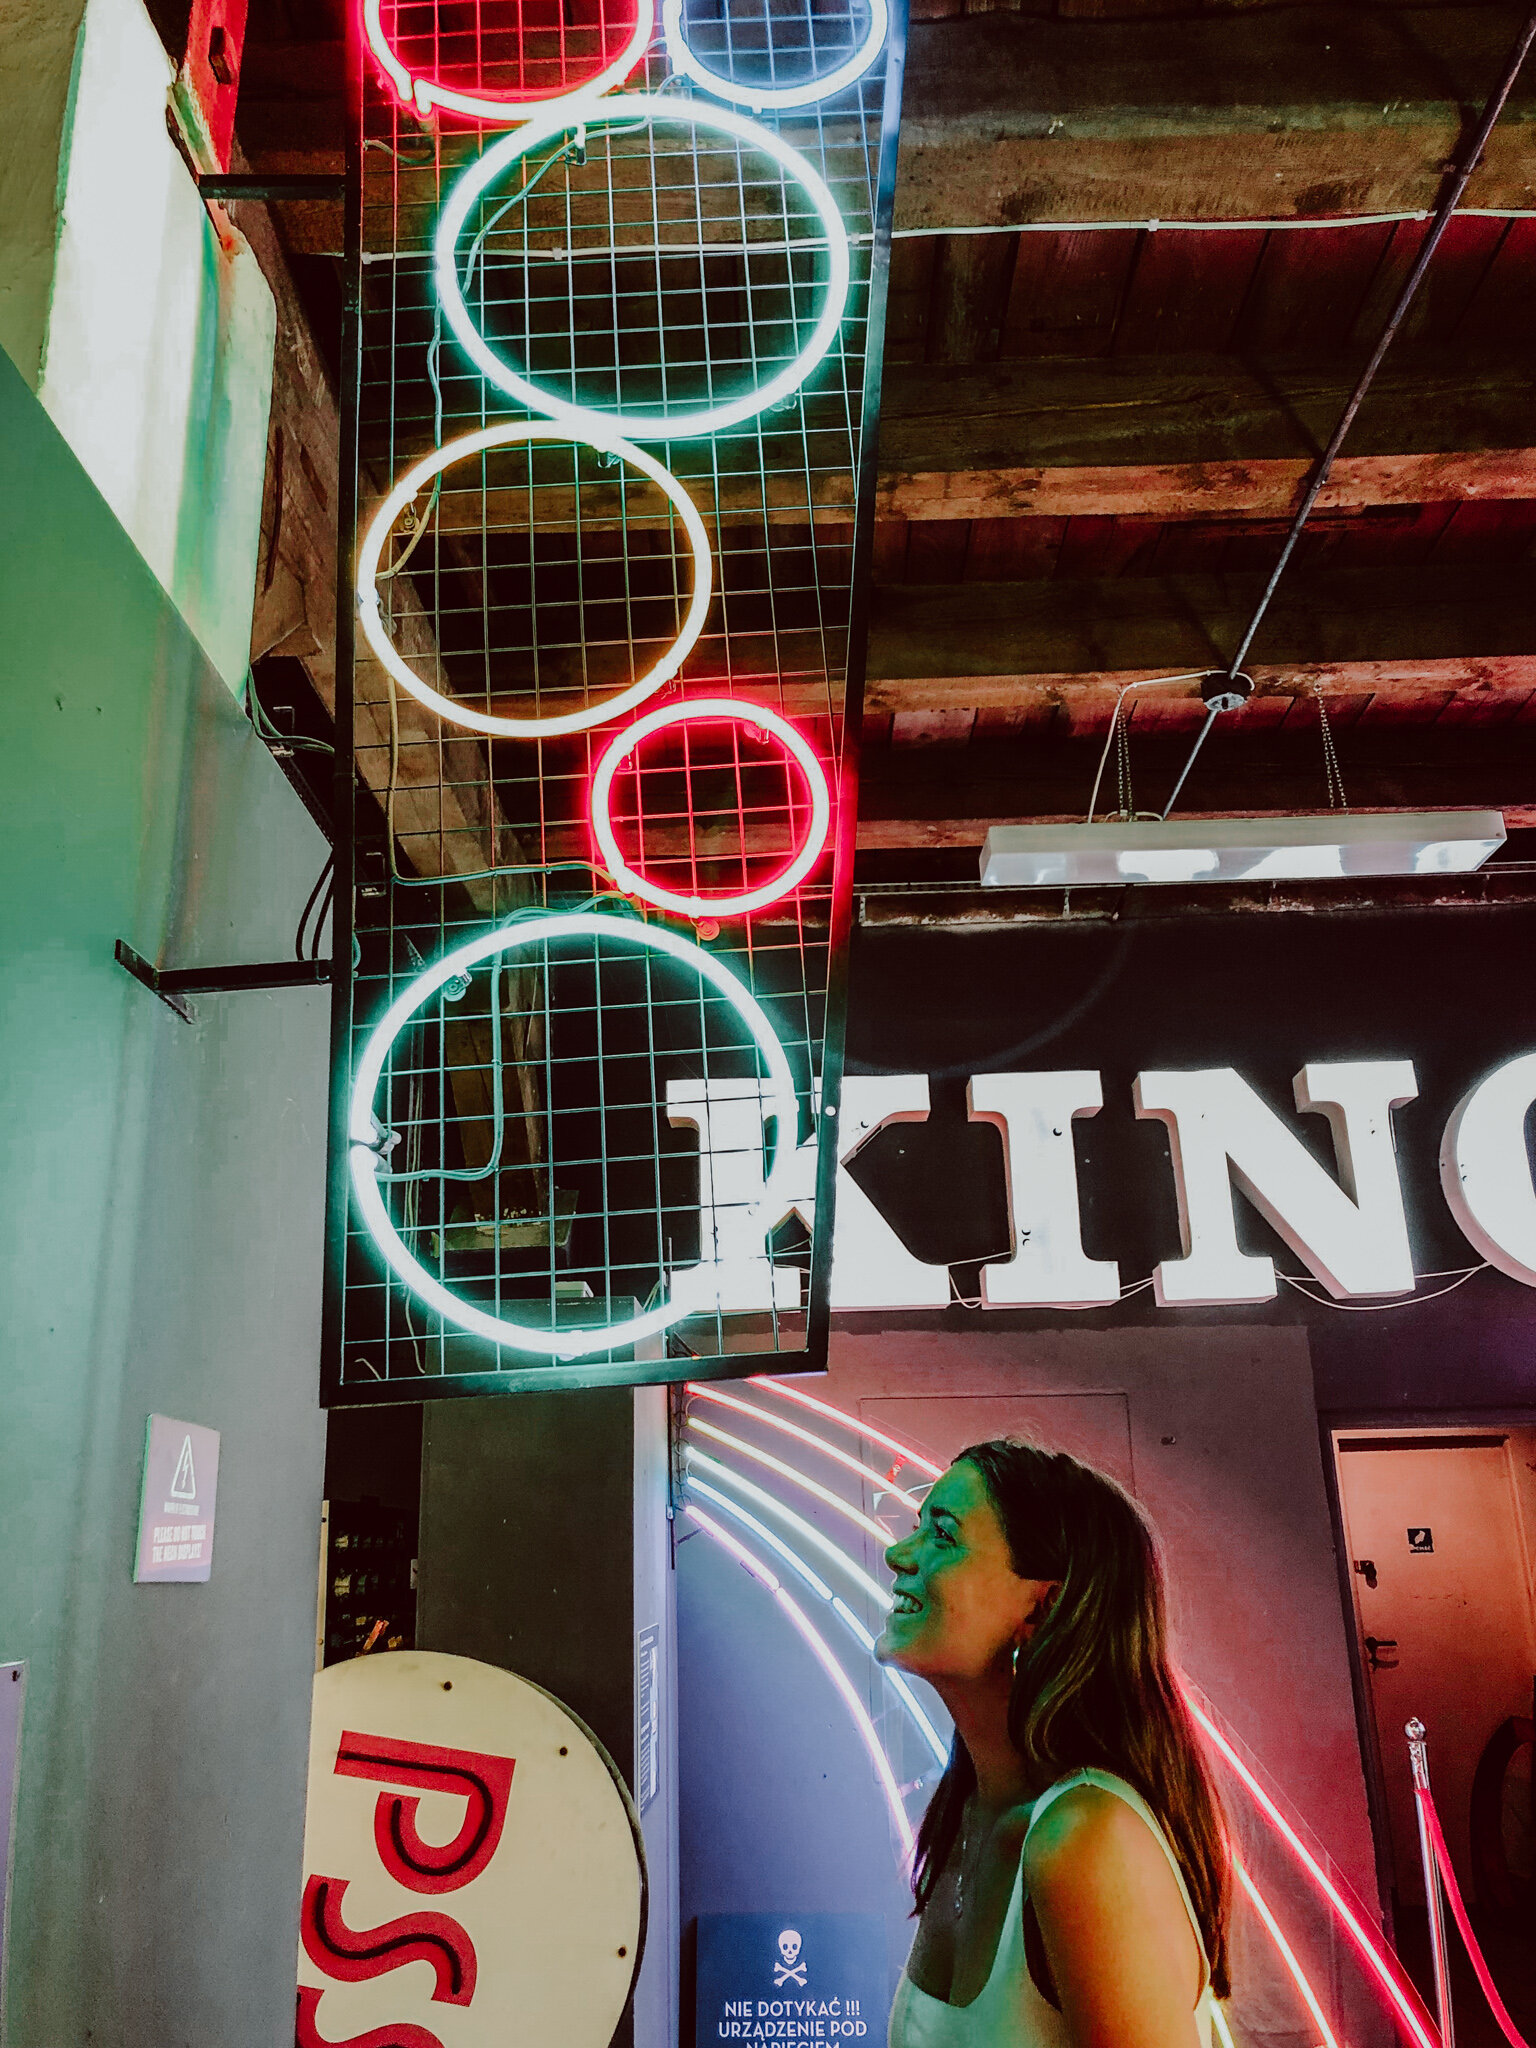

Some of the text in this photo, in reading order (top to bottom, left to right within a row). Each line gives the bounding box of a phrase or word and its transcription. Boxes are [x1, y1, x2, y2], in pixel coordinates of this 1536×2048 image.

[725, 1997, 860, 2017] NIE DOTYKAĆ !!!
[718, 2020, 867, 2041] URZĄDZENIE POD
